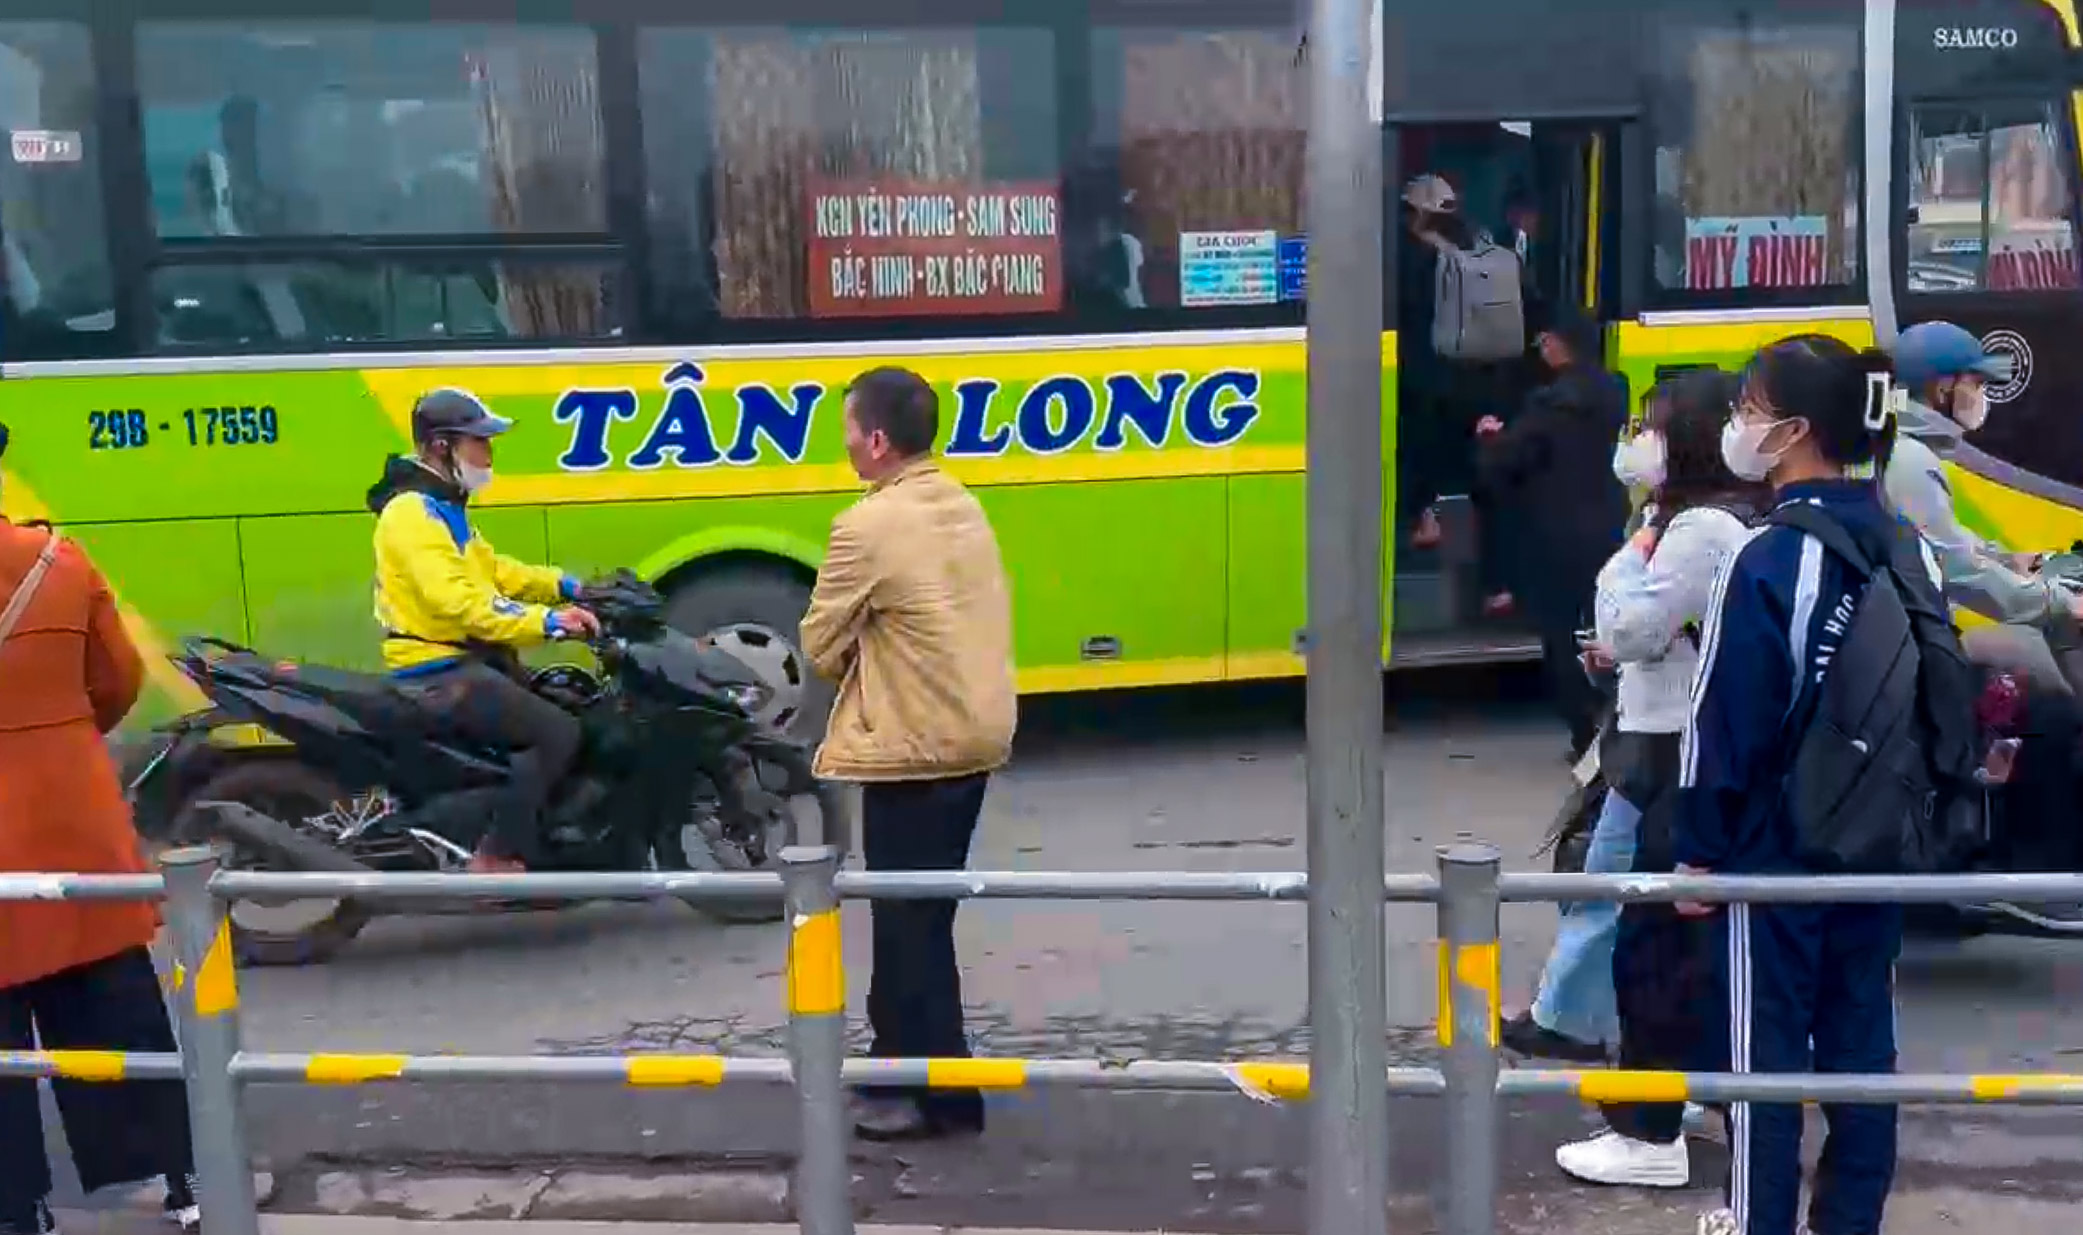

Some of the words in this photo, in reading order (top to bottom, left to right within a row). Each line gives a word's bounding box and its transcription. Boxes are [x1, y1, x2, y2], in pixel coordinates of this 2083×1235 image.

[1933, 27, 2018, 48] SAMCO
[896, 194, 955, 237] PHONG
[966, 195, 1005, 237] SAM
[1009, 195, 1056, 237] SUNG
[90, 409, 149, 449] 29B
[183, 405, 278, 446] 17559
[555, 362, 824, 467] TÂN
[945, 369, 1259, 456] LONG
